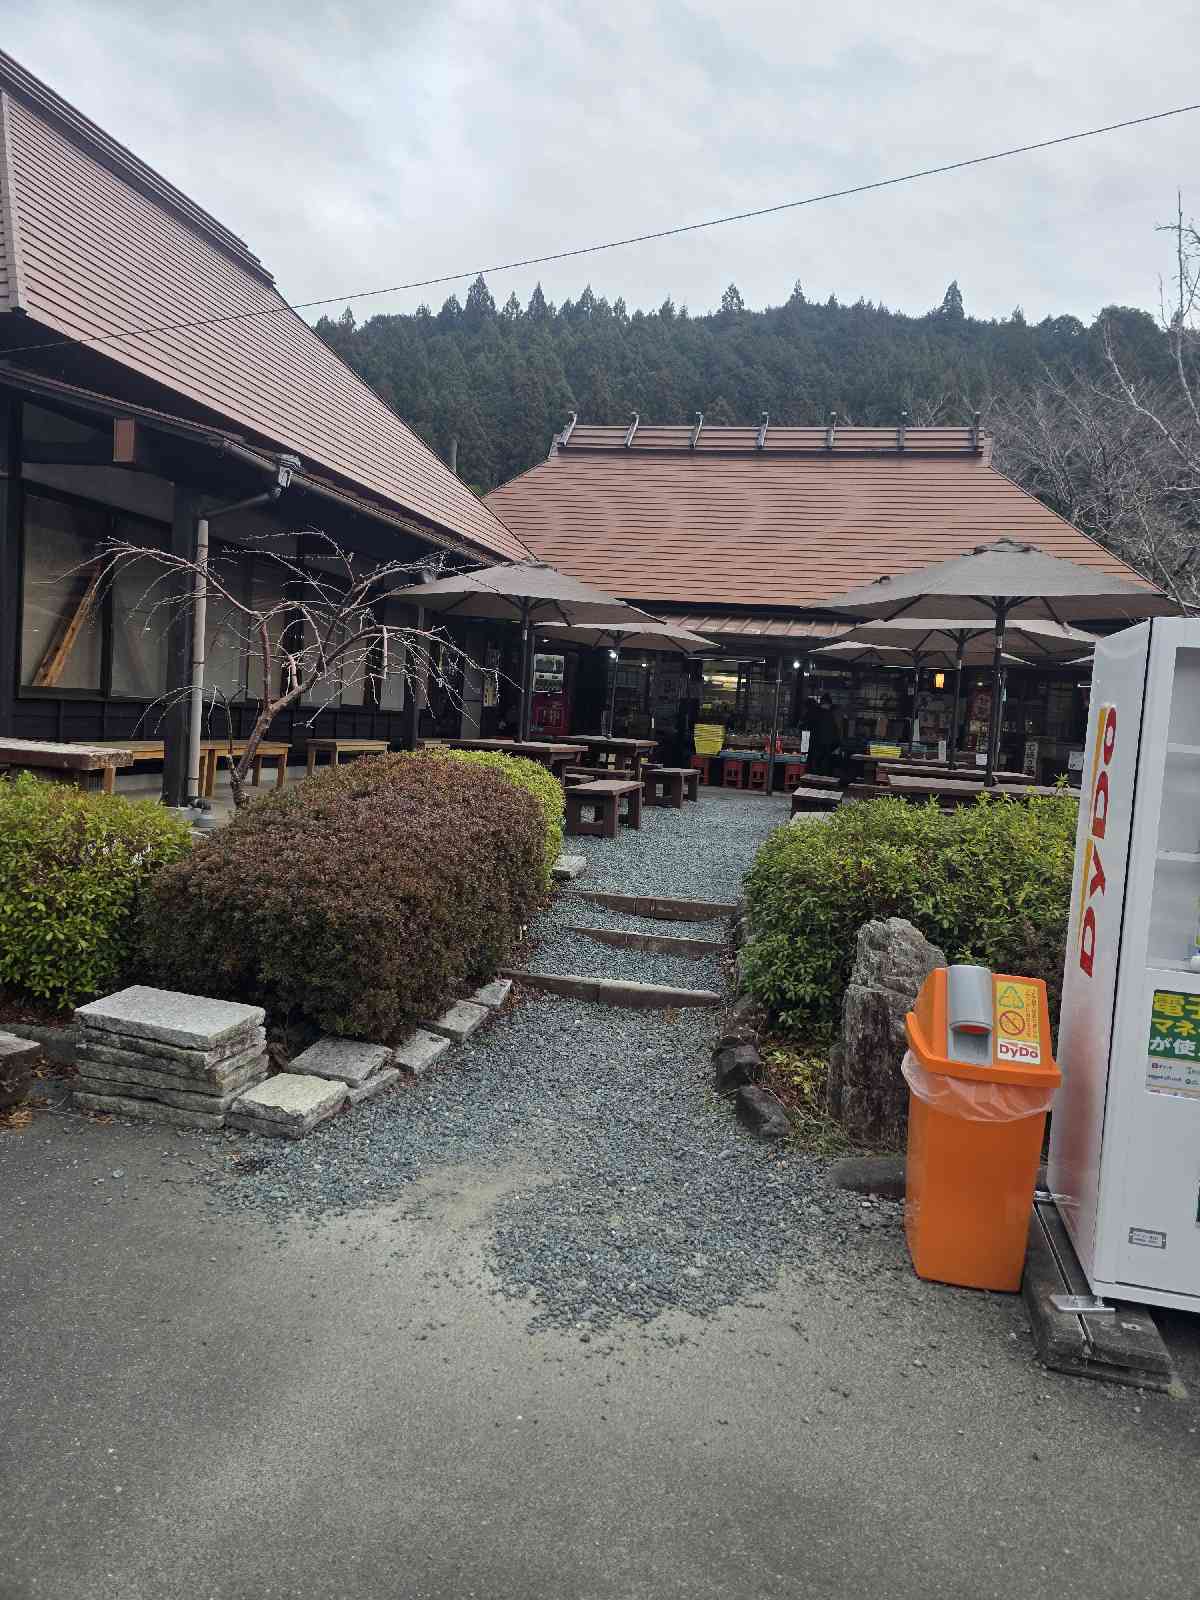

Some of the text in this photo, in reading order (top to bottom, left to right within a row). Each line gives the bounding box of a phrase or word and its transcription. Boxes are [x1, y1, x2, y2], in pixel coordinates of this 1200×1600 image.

[1151, 1018, 1200, 1037] マネ
[999, 1043, 1039, 1059] DyDo
[1149, 1036, 1200, 1057] が使
